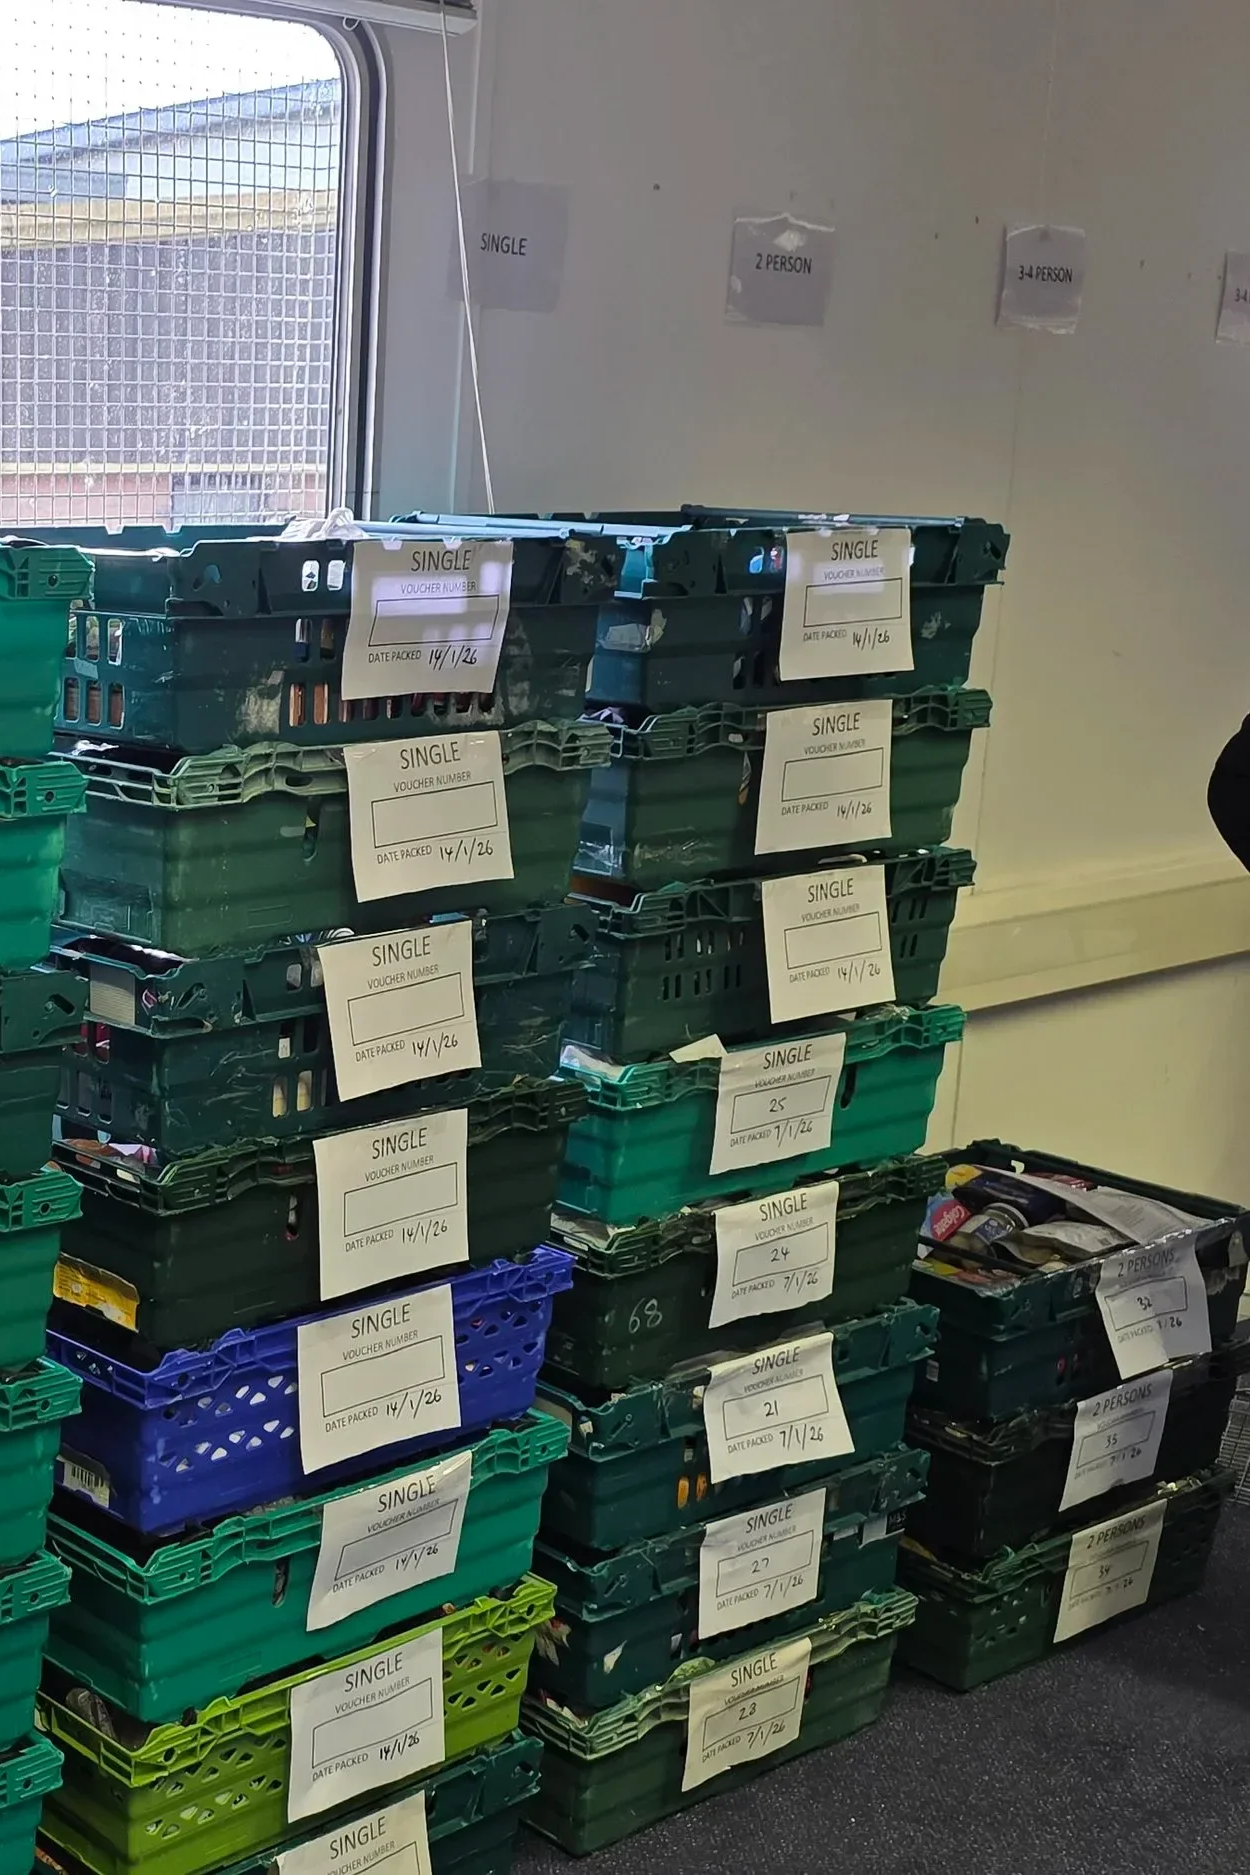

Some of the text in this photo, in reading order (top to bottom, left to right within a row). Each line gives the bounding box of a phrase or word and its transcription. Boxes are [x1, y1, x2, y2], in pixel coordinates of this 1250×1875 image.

[480, 232, 527, 256] SINGLE
[755, 253, 812, 274] 2 PERSON
[1018, 265, 1073, 283] 3-4 PERSON
[411, 549, 471, 572] SINGLE
[831, 539, 878, 561] SINGLE
[401, 581, 476, 594] VOUCHER NUMBER
[853, 628, 890, 650] 14/1/26
[368, 645, 477, 670] DATE PACKED 14/1/26
[812, 712, 860, 736] SINGLE
[400, 741, 460, 770] SINGLE
[394, 771, 471, 793] VOUCHER NUMBER
[837, 800, 872, 819] 14/1/26
[377, 837, 493, 864] DATE PACKED 14/1/26
[808, 878, 853, 903] SINGLE
[372, 935, 430, 967] SINGLE
[367, 964, 438, 989] VOUCHER NUMBER
[838, 959, 880, 983] 14/1/26
[355, 1032, 458, 1062] DATE PACKED 14/1/26
[763, 1044, 812, 1070] SINGLE
[769, 1097, 786, 1113] 25
[774, 1118, 813, 1140] 7/1/26
[372, 1127, 427, 1160] SINGLE
[365, 1155, 433, 1182] VOUCHER NUMBER
[759, 1193, 807, 1222] SINGLE
[345, 1219, 447, 1252] DATE PACKED 14/1/26
[771, 1247, 790, 1262] 24
[1117, 1250, 1175, 1277] 2 PERSONS
[784, 1270, 818, 1293] 7/1/26
[351, 1303, 410, 1339] SINGLE
[629, 1297, 663, 1334] 68
[343, 1330, 418, 1360] VOUCHER NUMBER
[752, 1346, 800, 1375] SINGLE
[325, 1388, 441, 1433] DATE PACKED 14/1/26
[764, 1400, 778, 1417] 21
[1093, 1383, 1152, 1417] 2 PERSONS
[727, 1423, 823, 1454] DATE PACKED 7/1/26
[378, 1475, 435, 1513] SINGLE
[746, 1503, 793, 1533] SINGLE
[1087, 1515, 1146, 1549] 2 PERSONS
[396, 1543, 438, 1570] 14/1/26
[752, 1557, 769, 1574] 27
[763, 1574, 804, 1599] 7/1/26
[345, 1652, 402, 1692] SINGLE
[731, 1652, 777, 1687] SINGLE
[335, 1676, 410, 1714] VOUCHER NUMBER
[747, 1721, 785, 1749] 7/1/26
[313, 1731, 420, 1782] DATE PACKED 14/1/26
[329, 1816, 387, 1860] SINGLE
